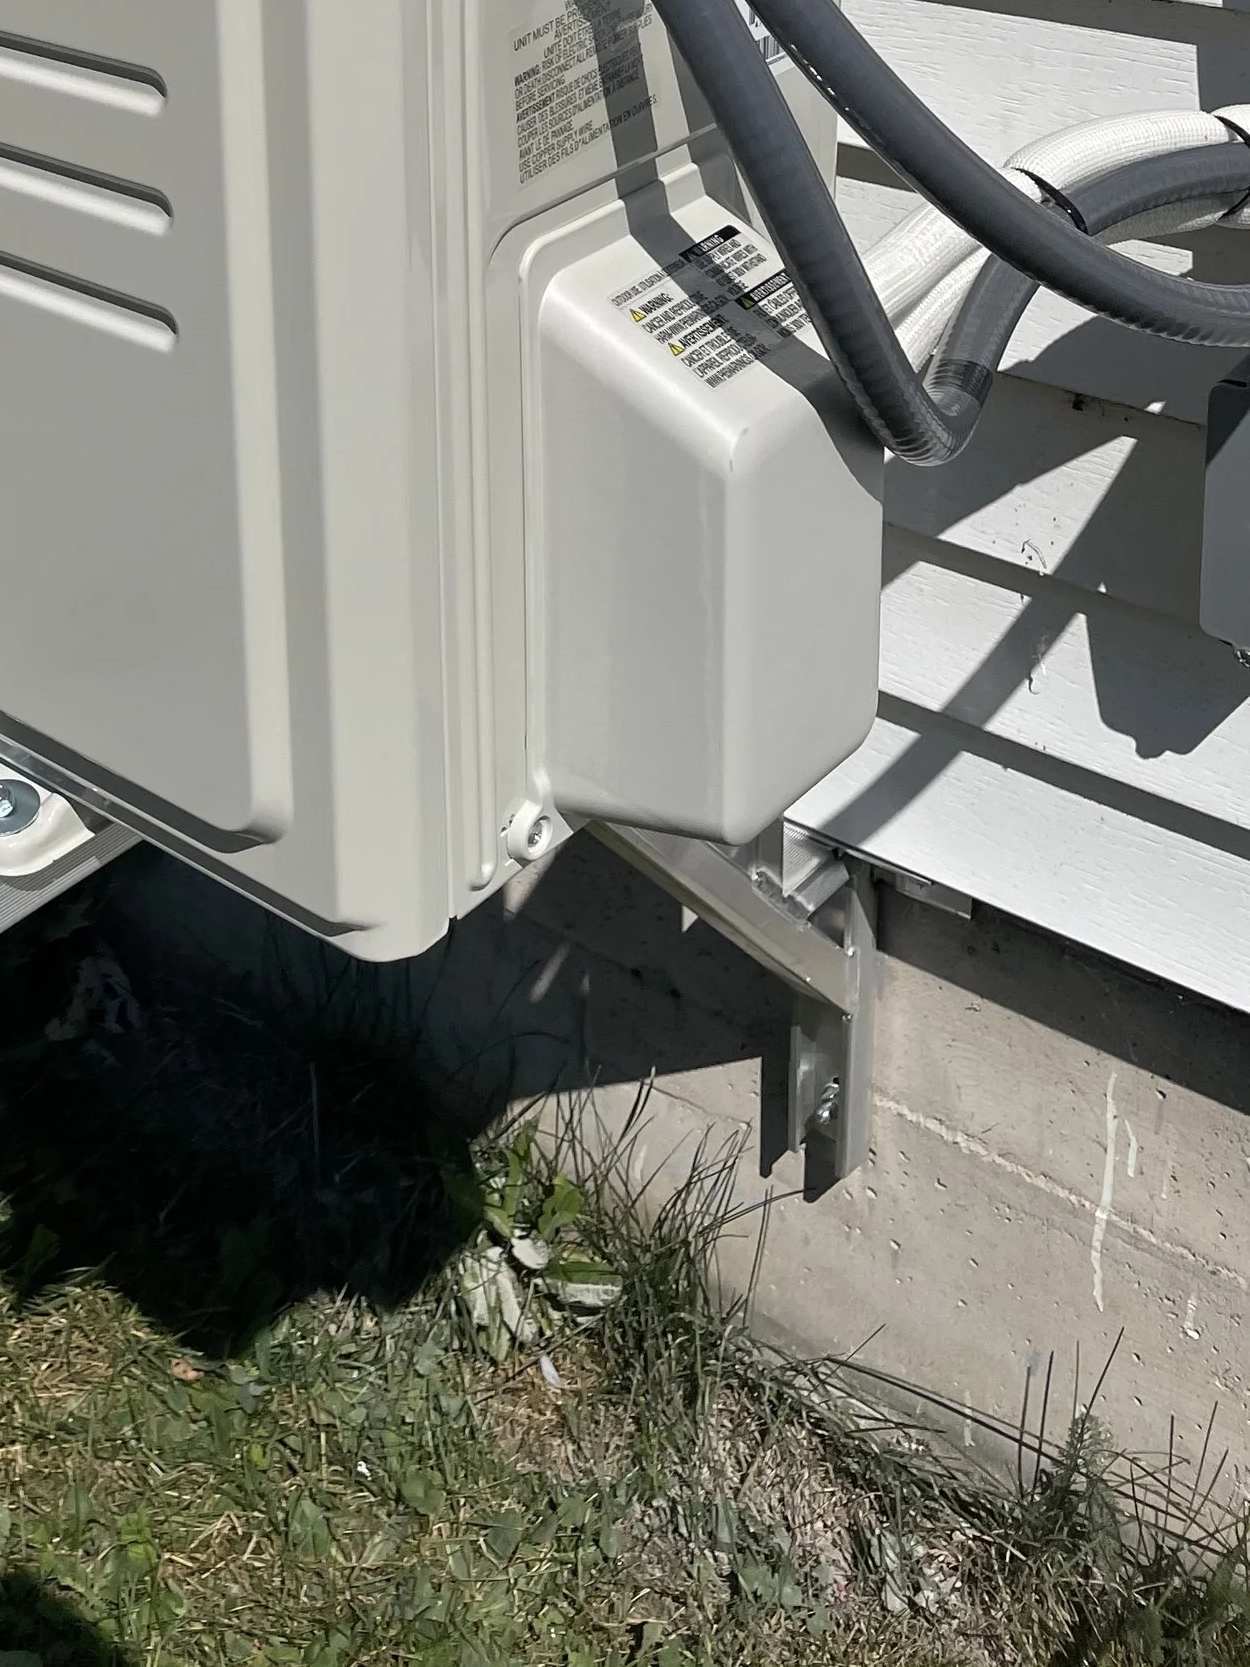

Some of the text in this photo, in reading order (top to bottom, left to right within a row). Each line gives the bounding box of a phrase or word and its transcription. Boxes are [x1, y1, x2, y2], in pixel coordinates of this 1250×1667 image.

[513, 31, 532, 53] UNIT
[532, 18, 554, 42] MUST
[555, 12, 566, 29] BE
[518, 154, 531, 173] USE
[531, 140, 556, 166] COPPER
[691, 234, 724, 255] WARNING
[640, 315, 667, 333] CANCER
